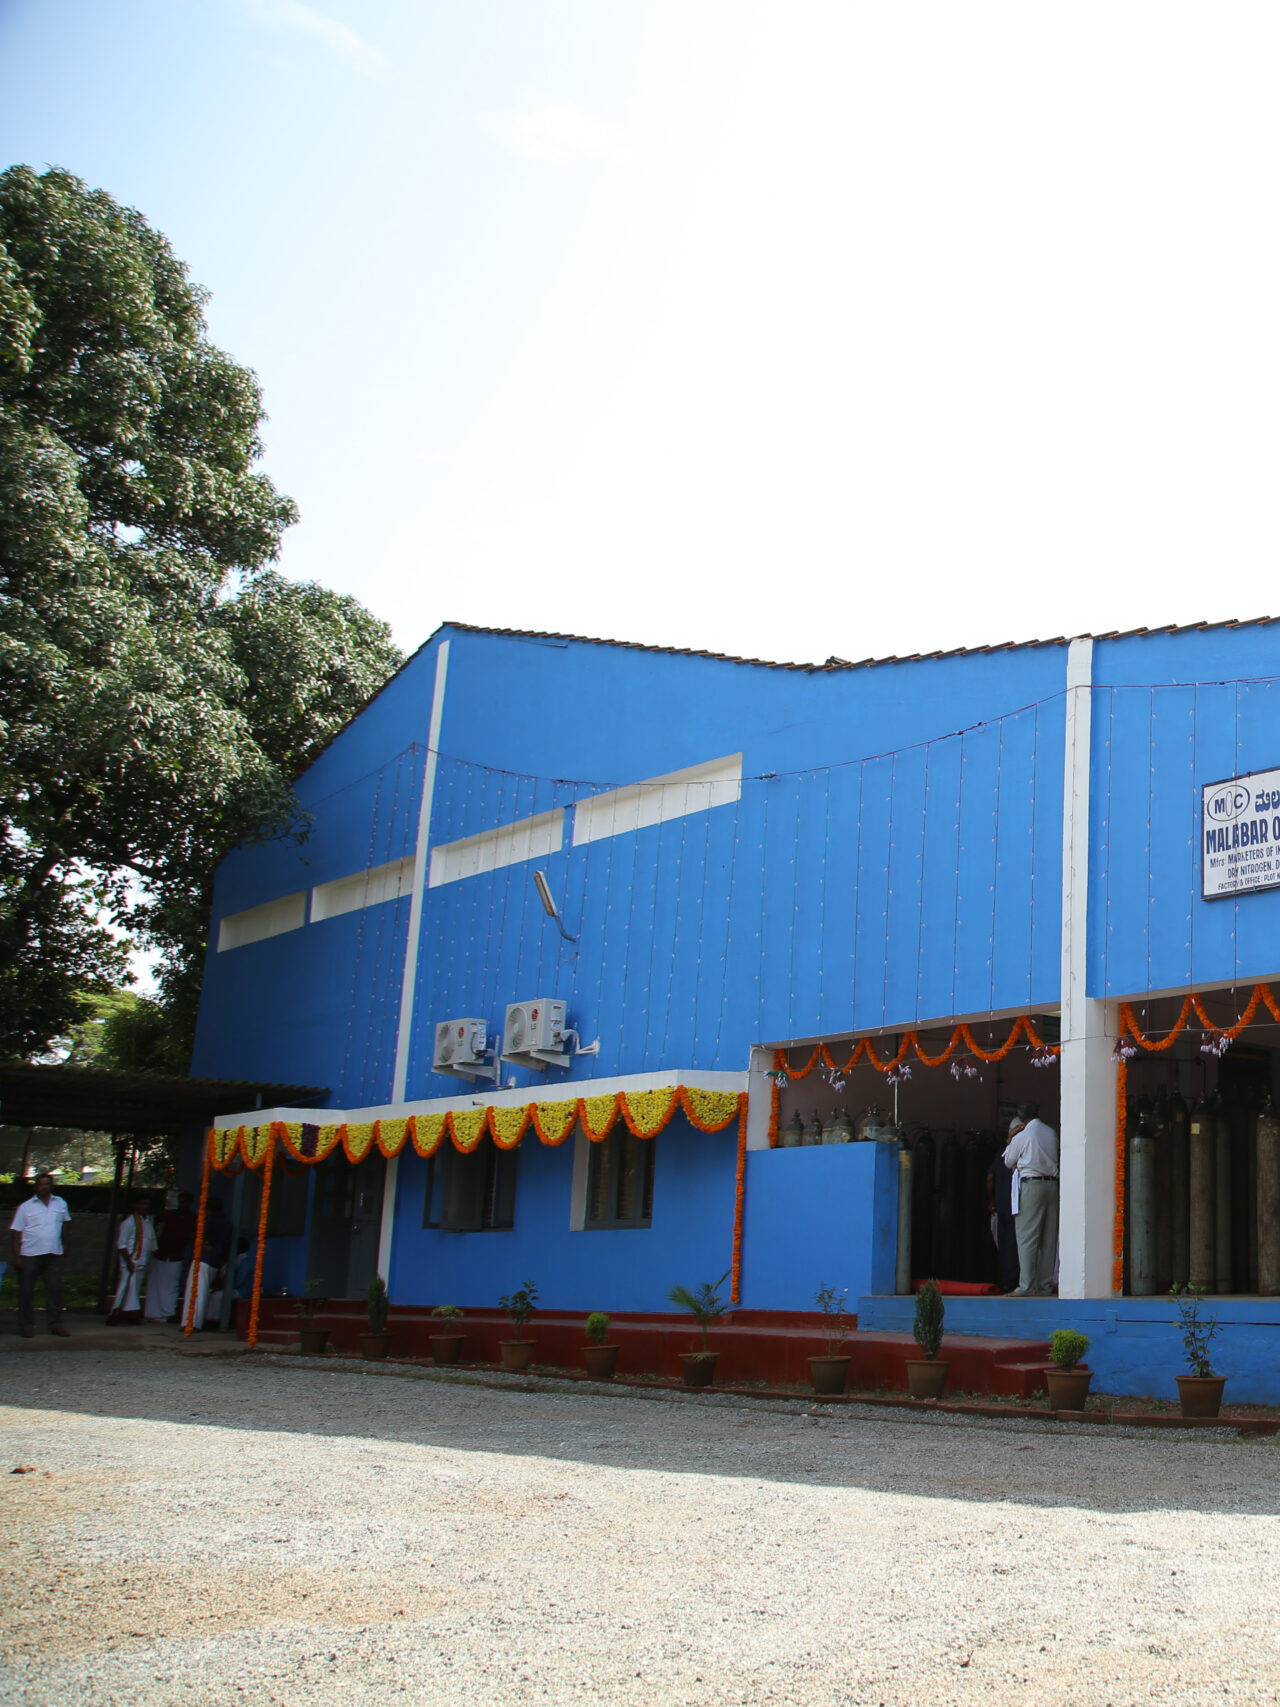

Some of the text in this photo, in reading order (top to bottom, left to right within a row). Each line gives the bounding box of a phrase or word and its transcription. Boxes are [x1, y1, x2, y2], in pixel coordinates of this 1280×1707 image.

[1206, 819, 1268, 854] MALABAR
[1266, 846, 1273, 857] OF
[1228, 867, 1238, 878] DRY
[1218, 879, 1238, 890] FACTORY
